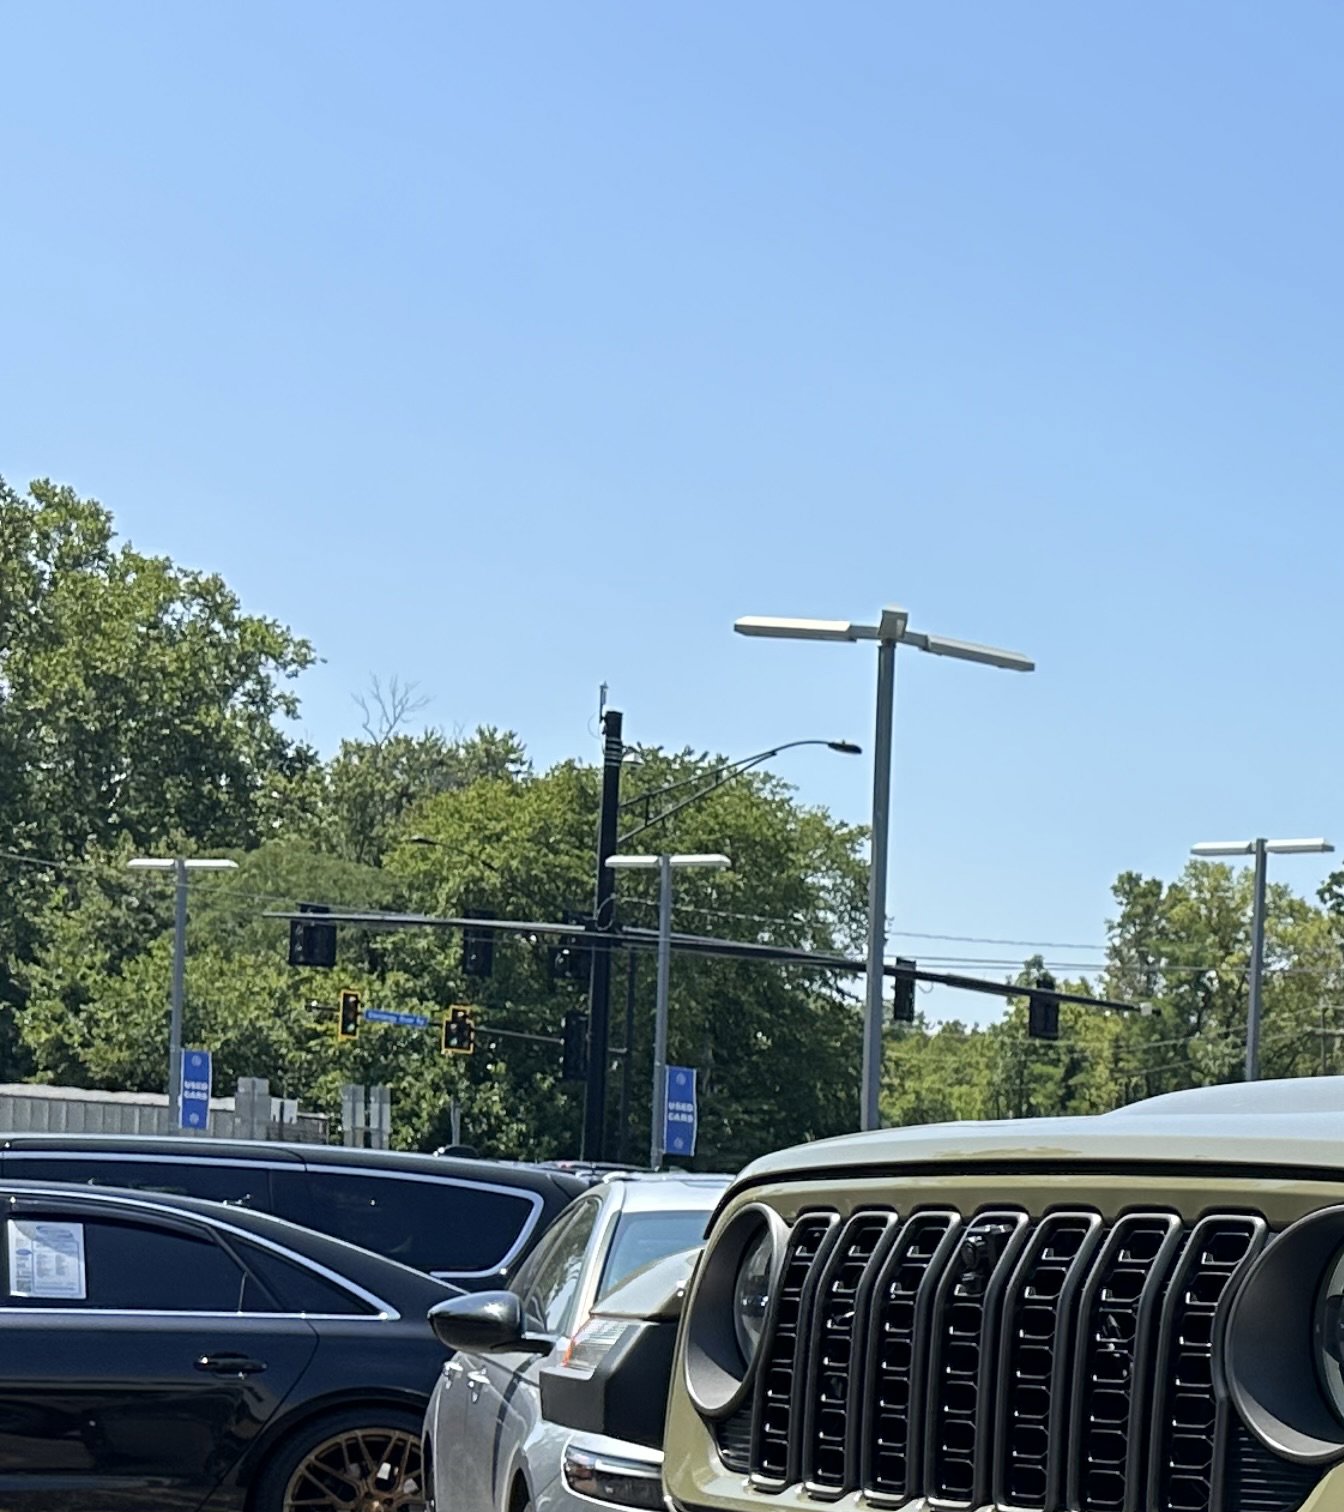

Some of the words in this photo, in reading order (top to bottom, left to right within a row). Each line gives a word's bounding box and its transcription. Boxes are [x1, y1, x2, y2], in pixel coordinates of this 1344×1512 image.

[184, 1080, 208, 1091] USED
[184, 1090, 207, 1101] CARS
[668, 1102, 694, 1112] USED
[668, 1112, 693, 1123] CARS
